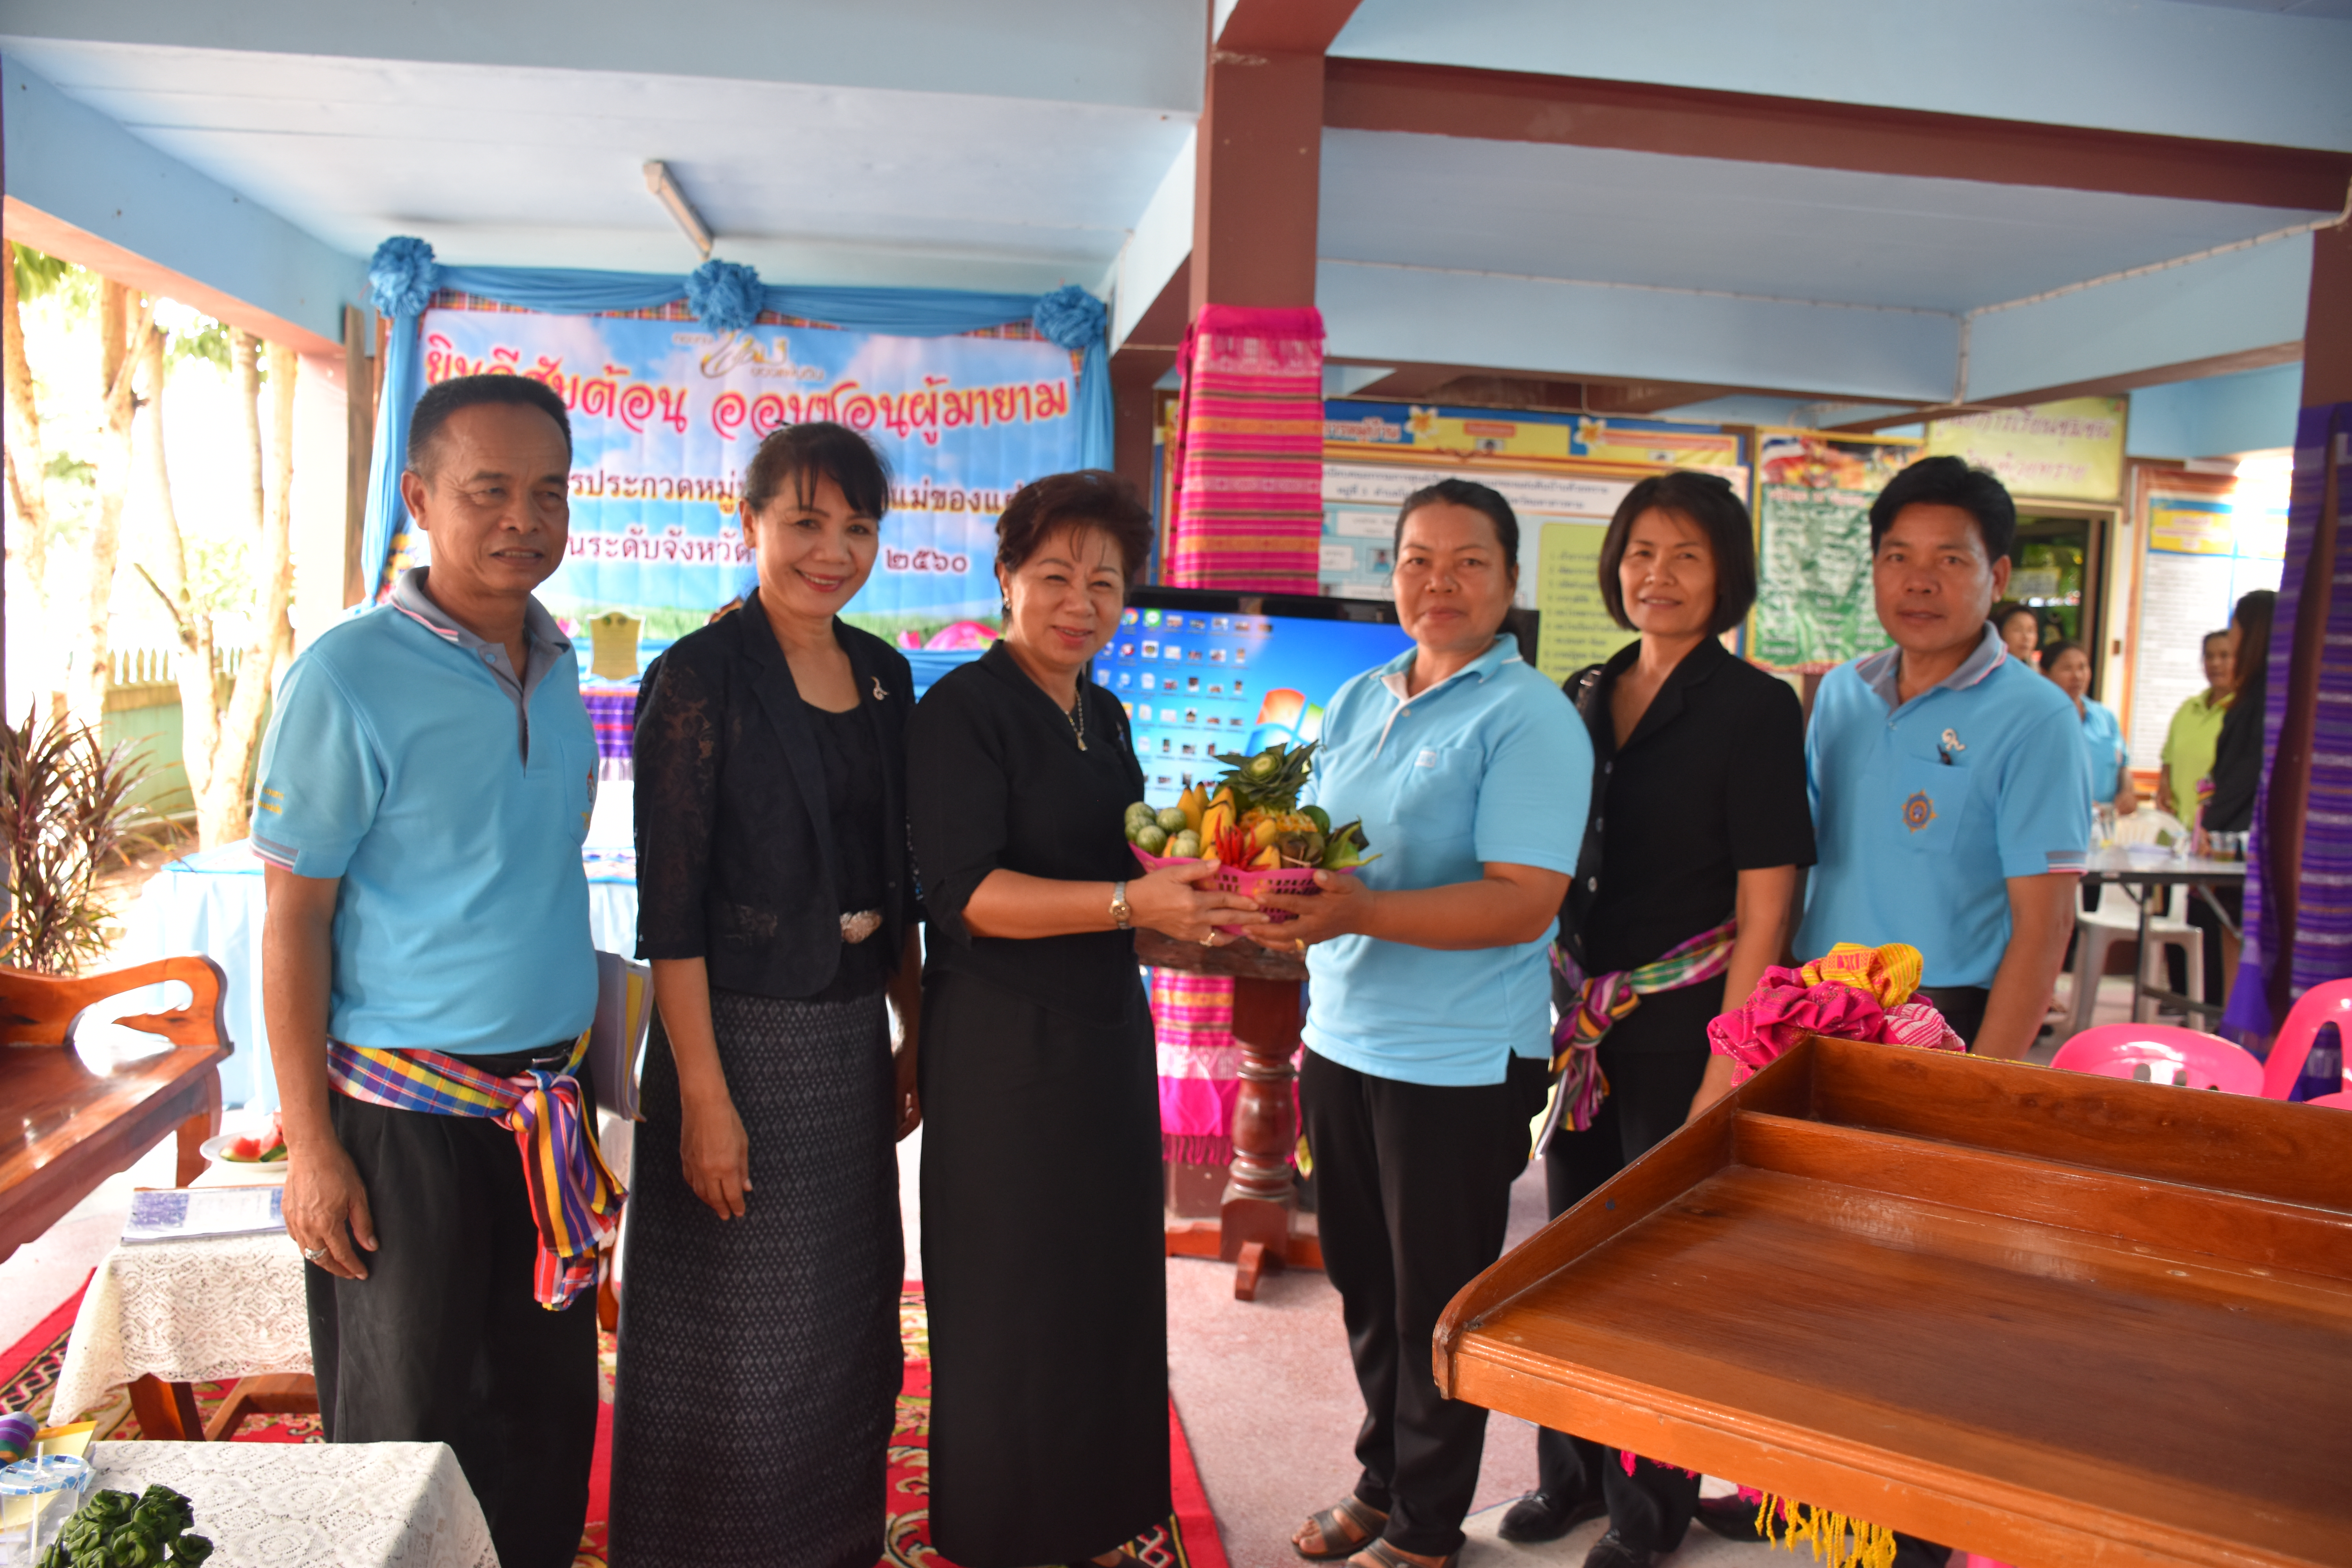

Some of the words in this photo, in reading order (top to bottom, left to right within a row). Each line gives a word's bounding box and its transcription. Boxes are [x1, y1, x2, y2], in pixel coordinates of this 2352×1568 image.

[571, 469, 744, 512] รประกวดหมู่
[891, 479, 1022, 511] แม่ของแ่
[887, 550, 968, 572] ๒๕๖๐
